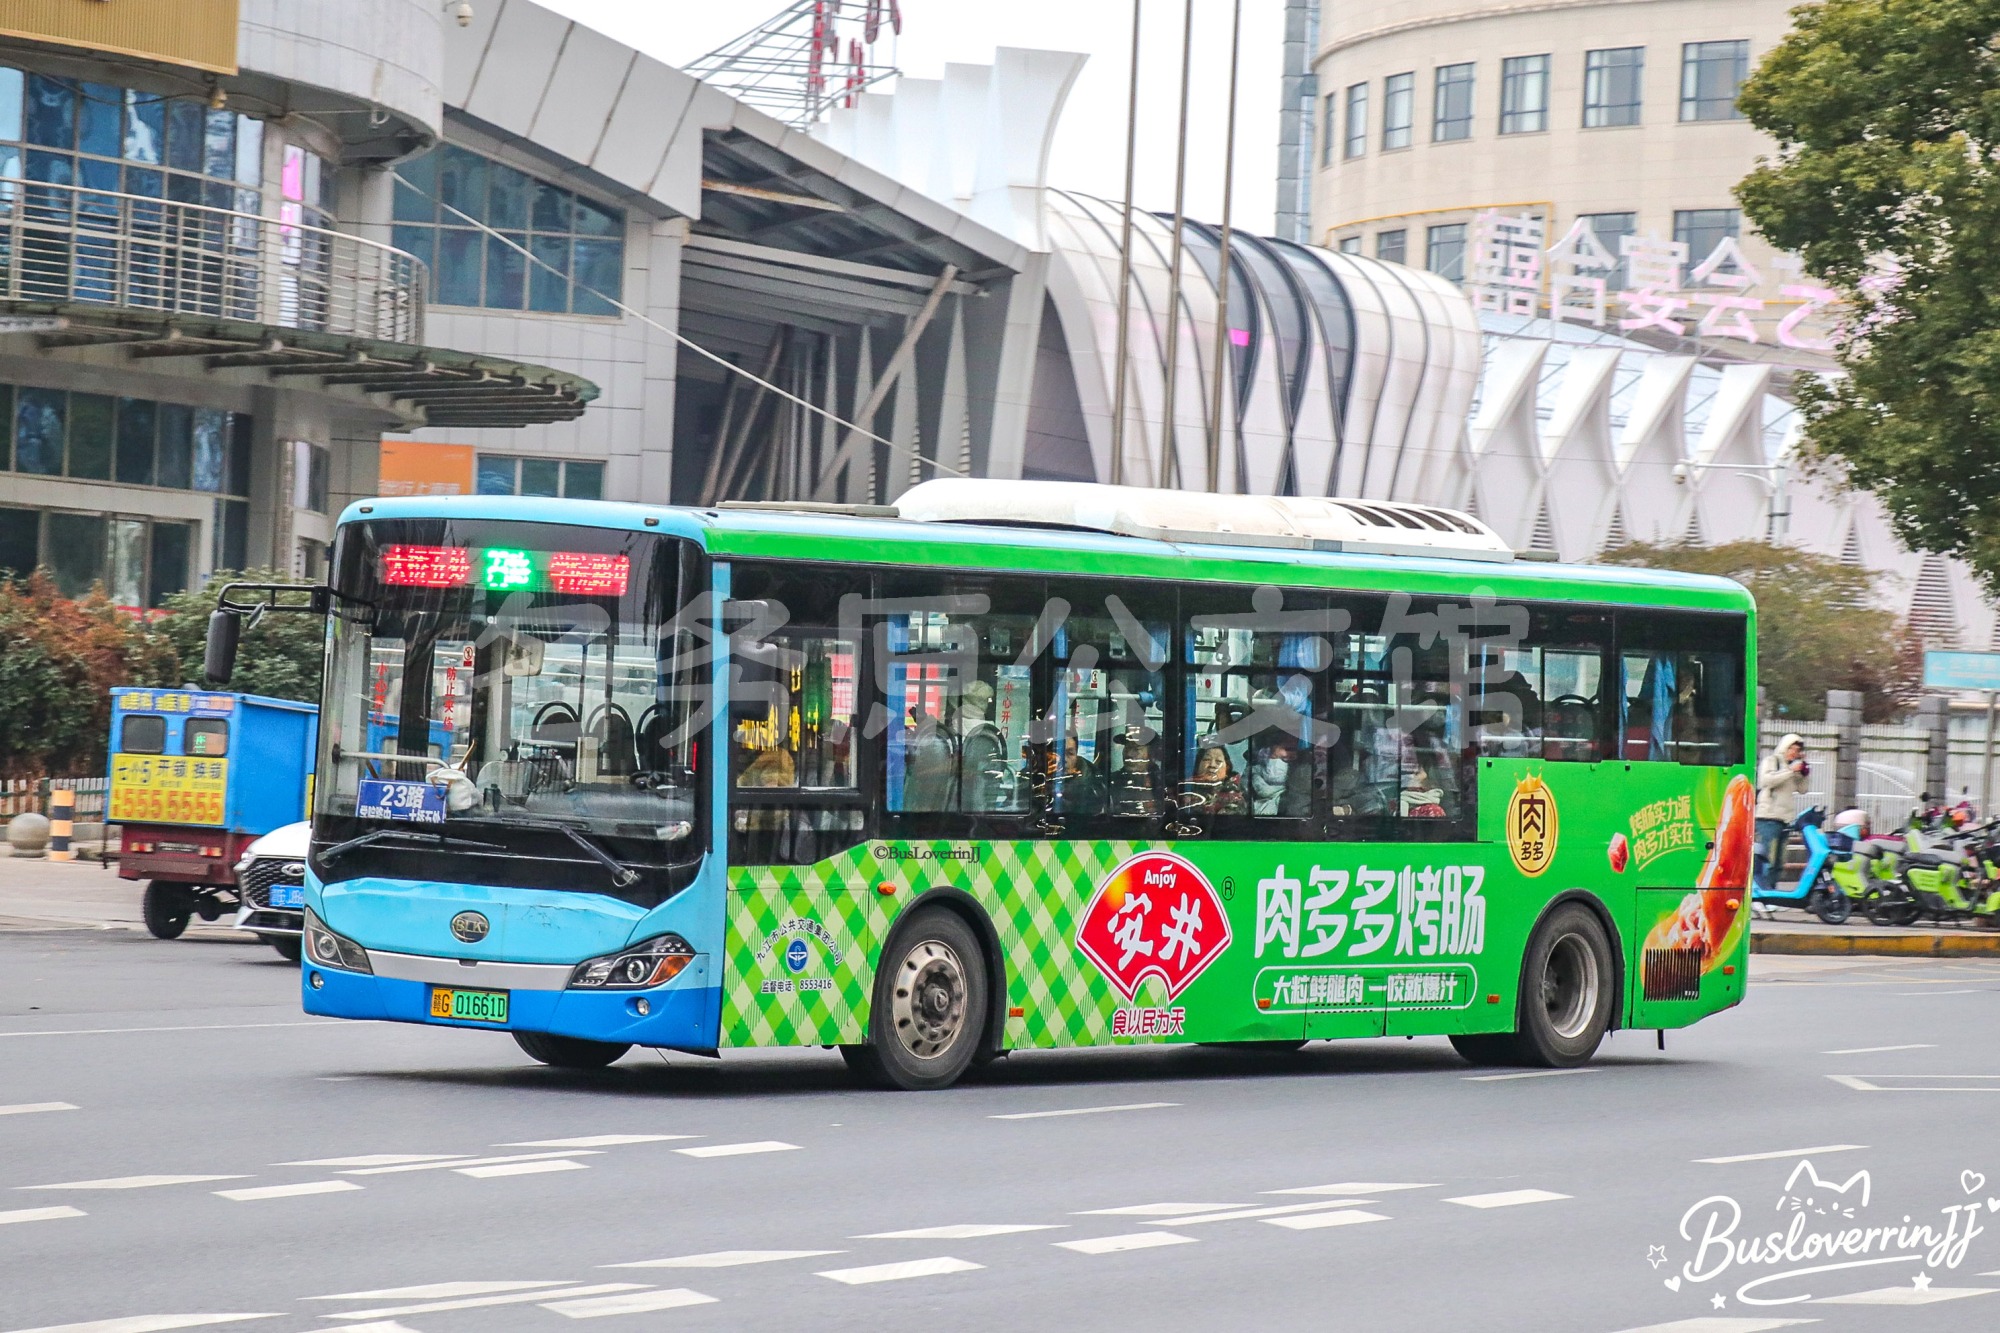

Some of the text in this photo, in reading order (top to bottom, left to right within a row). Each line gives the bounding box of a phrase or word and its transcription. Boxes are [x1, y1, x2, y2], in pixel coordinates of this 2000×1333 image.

[380, 784, 425, 809] 23路
[1519, 794, 1546, 839] 肉
[1630, 795, 1690, 837] 烤肠实力派
[1521, 841, 1544, 861] 多多
[1634, 821, 1694, 865] 肉多才实在
[1144, 864, 1177, 888] Anjoy
[1107, 892, 1203, 971] 安井
[1254, 864, 1486, 959] 肉多多烤肠
[755, 918, 843, 966] 九江市公共交通集团公司
[799, 979, 832, 990] 8553416
[1112, 1007, 1185, 1036] 食以民为天
